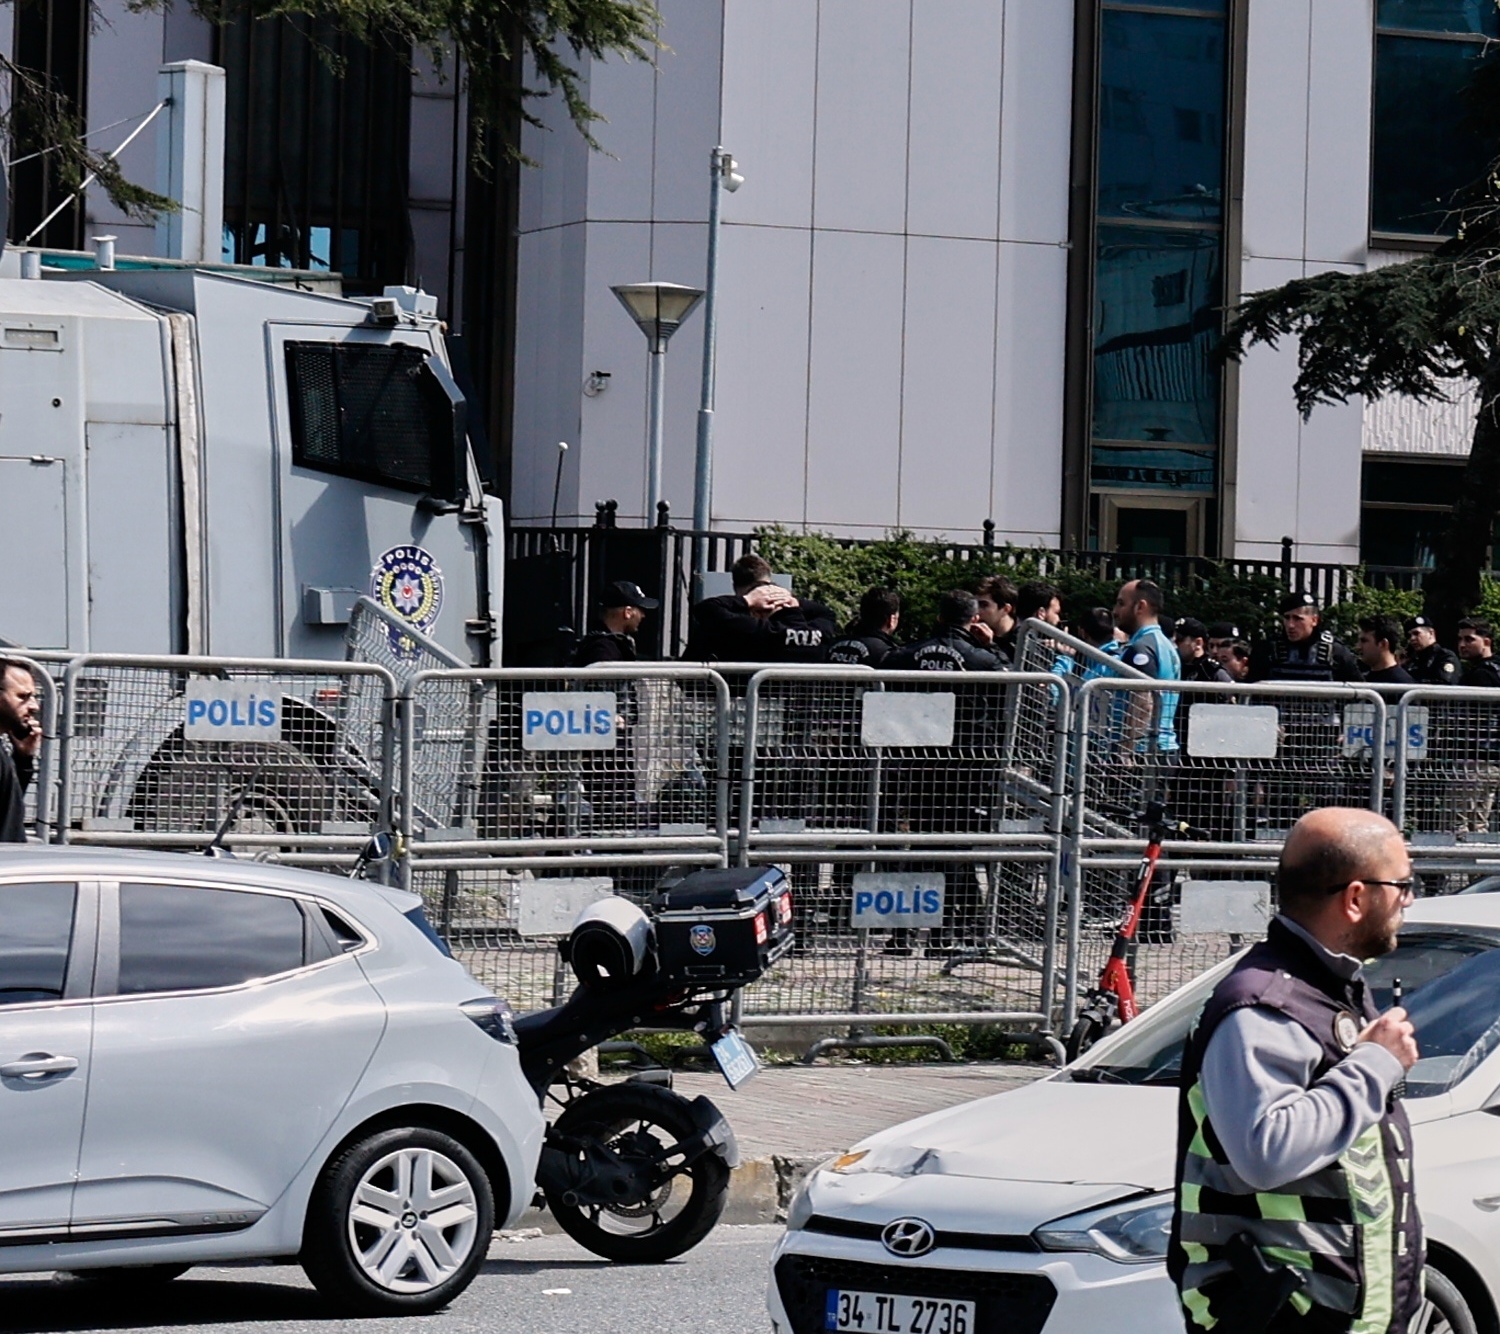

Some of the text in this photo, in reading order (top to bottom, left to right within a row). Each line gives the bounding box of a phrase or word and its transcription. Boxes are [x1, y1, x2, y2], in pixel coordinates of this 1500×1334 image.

[385, 549, 430, 565] POLİS
[188, 693, 276, 727] POLİS
[526, 703, 611, 736] POLİS
[855, 885, 940, 916] POLİS
[202, 1214, 248, 1225] CLIO
[838, 1293, 864, 1329] 34
[875, 1297, 900, 1333] TL
